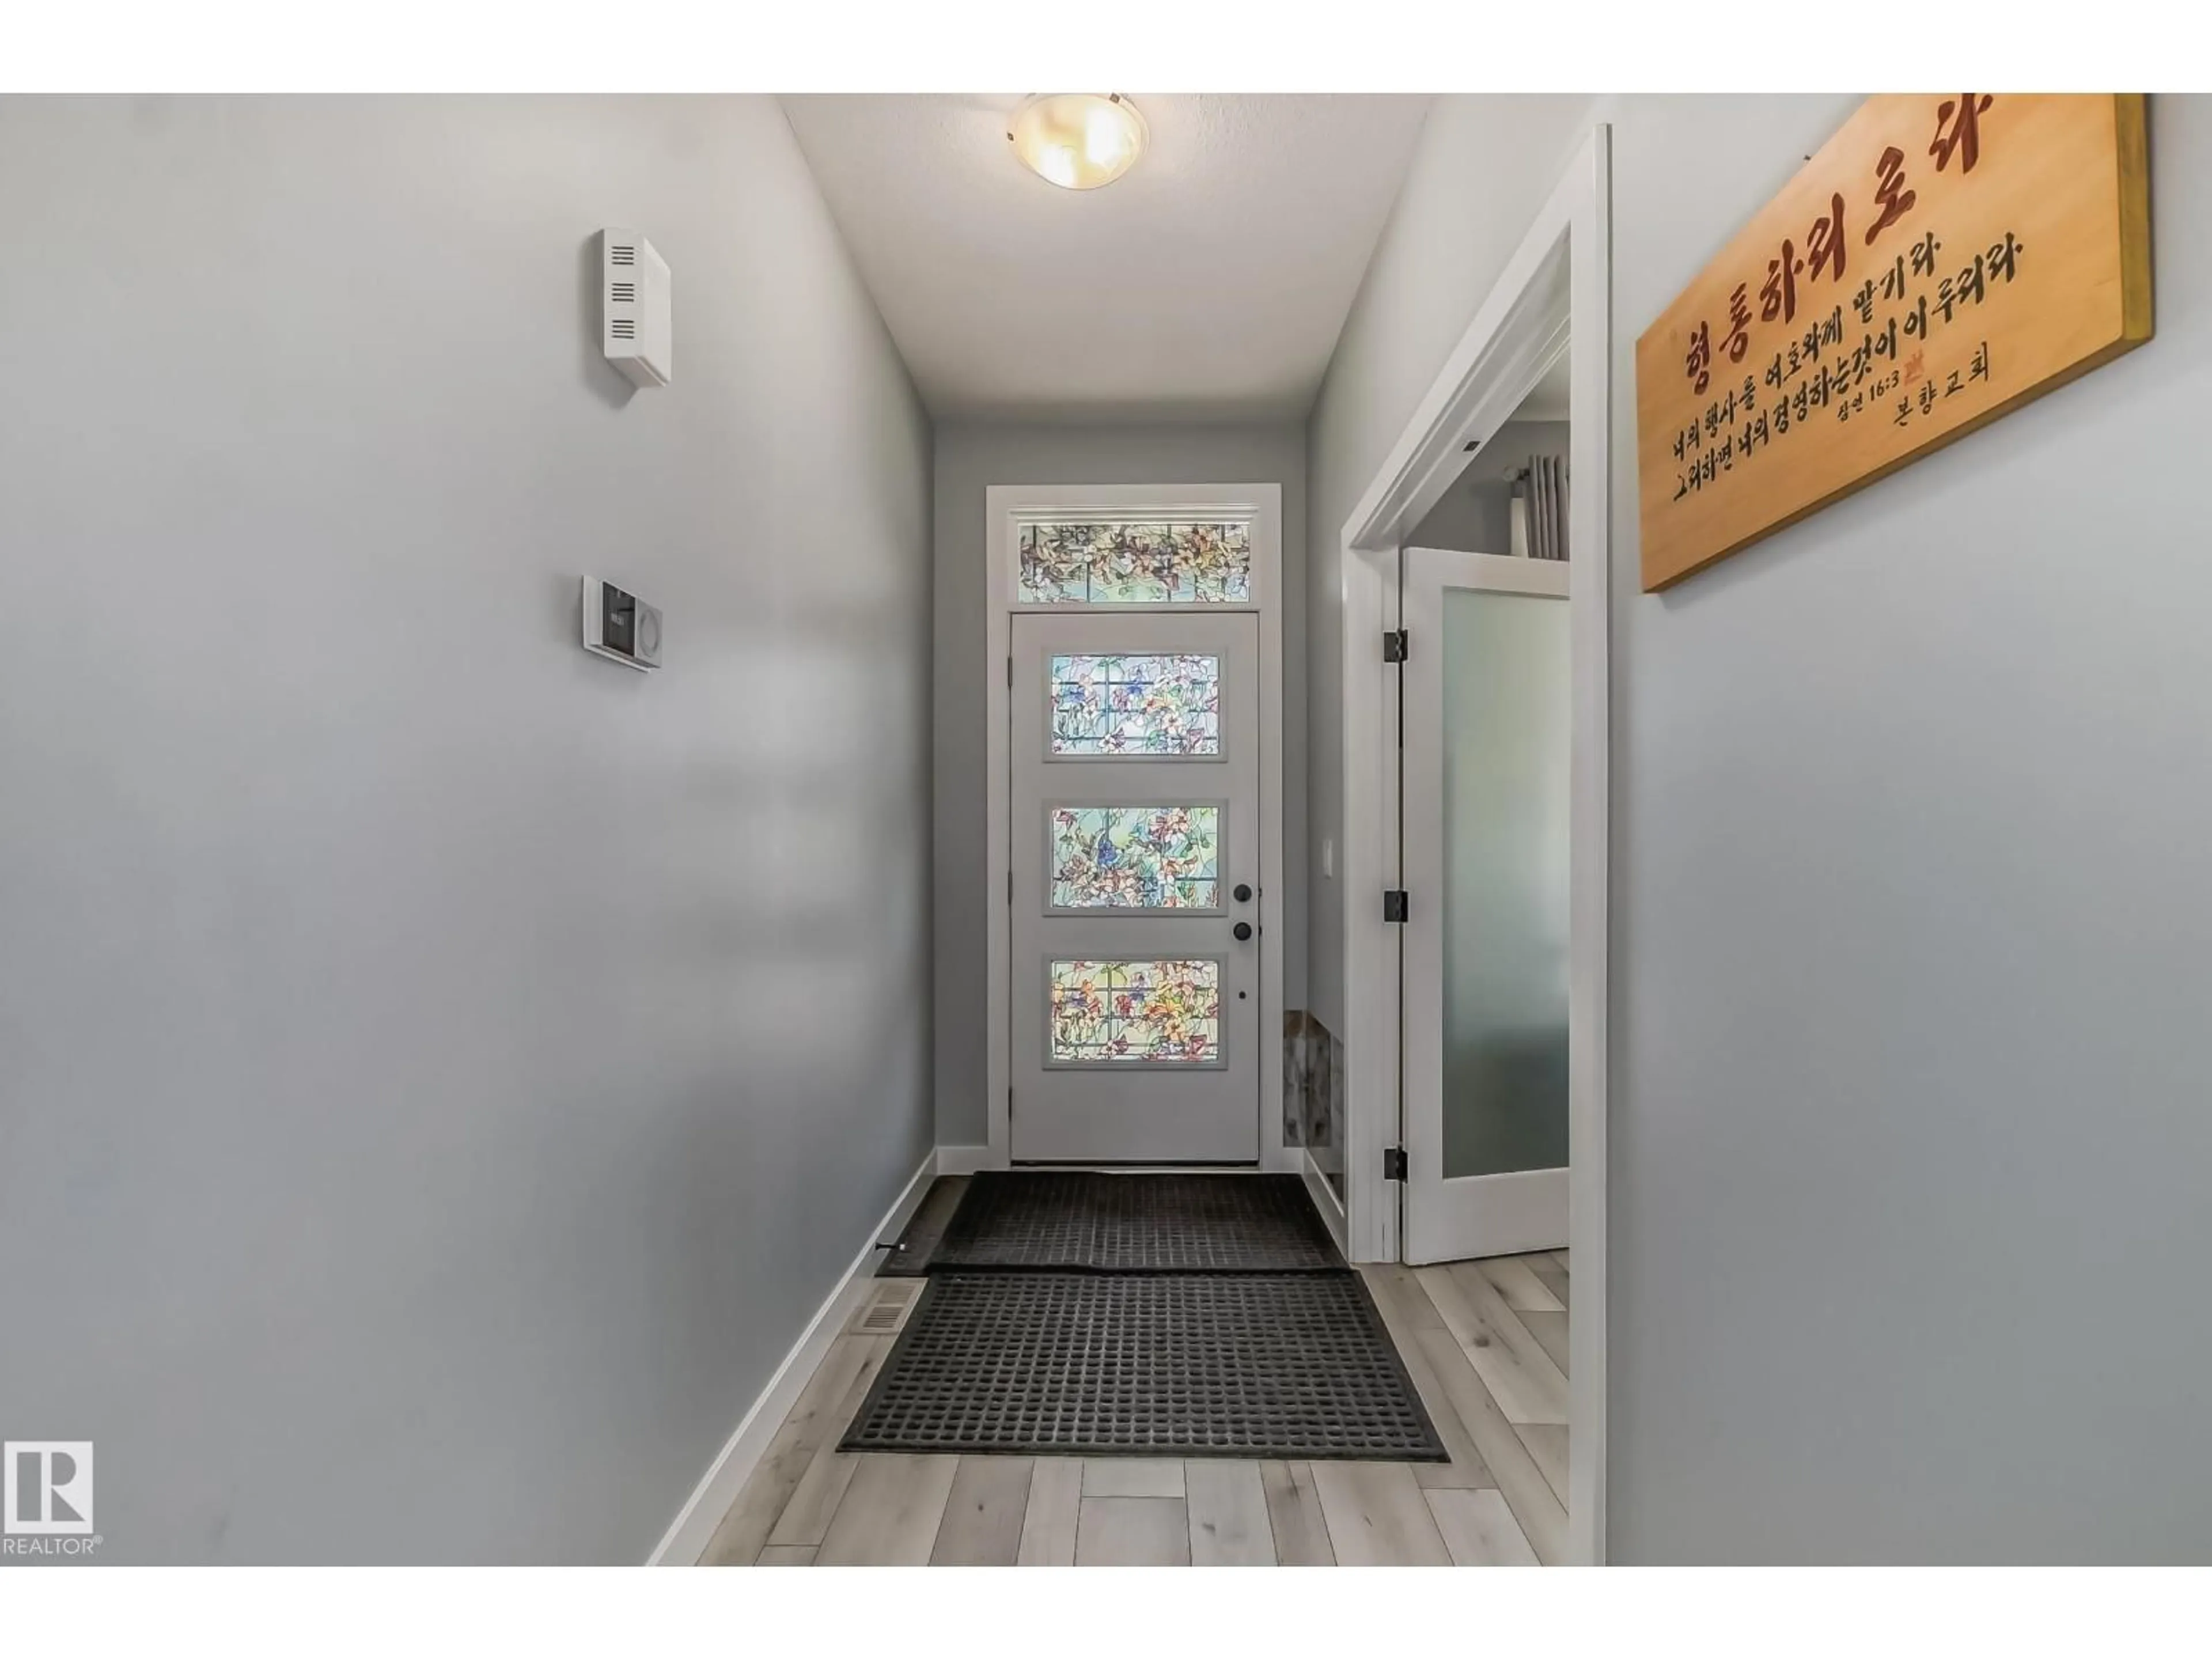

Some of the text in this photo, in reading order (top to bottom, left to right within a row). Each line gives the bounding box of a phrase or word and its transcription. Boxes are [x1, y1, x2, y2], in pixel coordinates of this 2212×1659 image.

[1673, 417, 1700, 460] 너의
[1705, 375, 1756, 438] 행사를
[1765, 305, 1842, 389] 여호와께
[1853, 231, 1941, 323] 맡기라
[1869, 370, 1900, 401] 16:3
[1673, 434, 1732, 501] 그리하면
[1738, 409, 1769, 457] 너의
